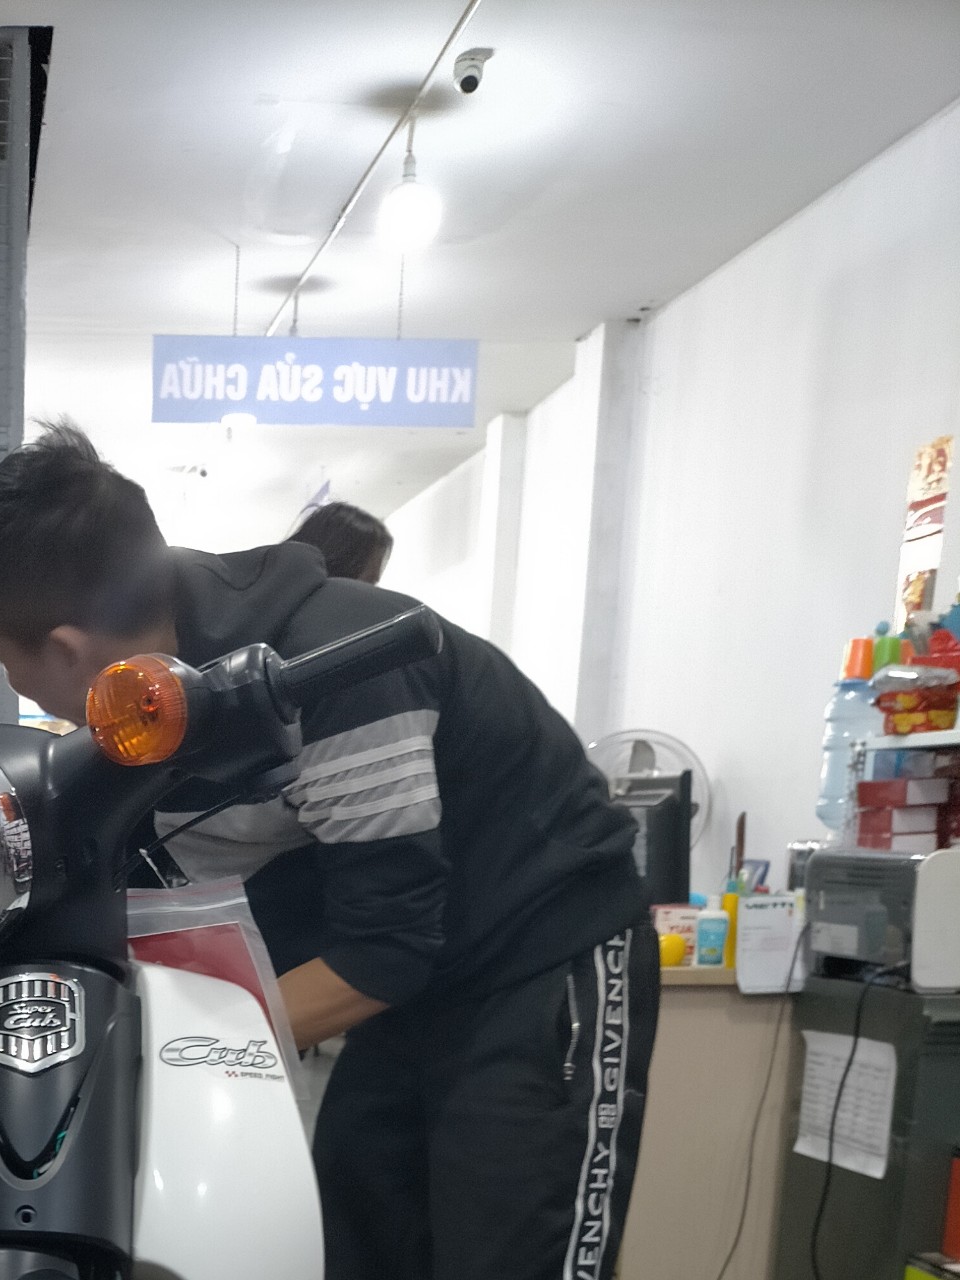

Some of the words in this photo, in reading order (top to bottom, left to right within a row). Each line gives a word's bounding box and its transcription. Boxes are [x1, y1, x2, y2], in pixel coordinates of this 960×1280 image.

[8, 1003, 56, 1014] Super
[4, 1012, 62, 1030] Cub
[159, 1036, 278, 1069] Cub
